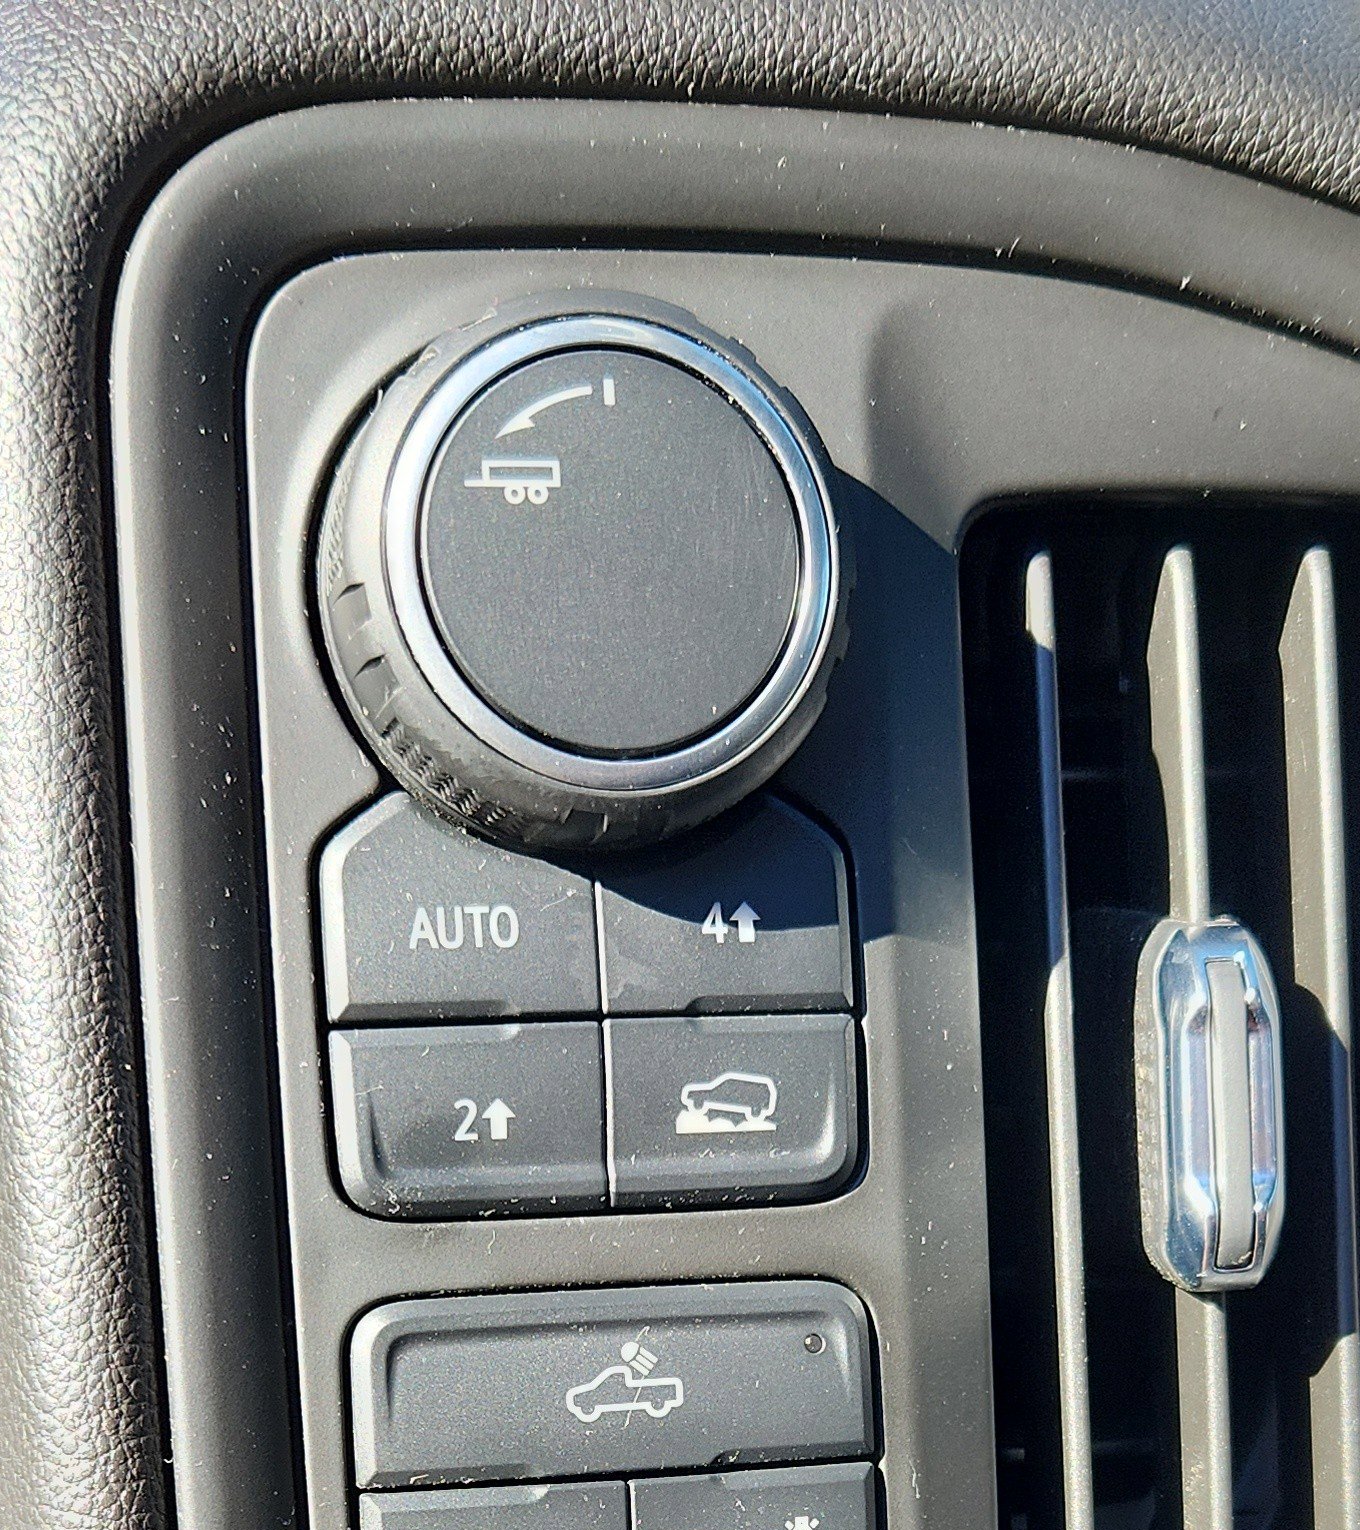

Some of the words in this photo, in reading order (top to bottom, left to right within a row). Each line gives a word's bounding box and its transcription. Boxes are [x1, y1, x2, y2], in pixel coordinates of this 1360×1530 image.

[408, 903, 520, 950] AUTO
[700, 900, 728, 945] 4
[452, 1099, 479, 1141] 2
